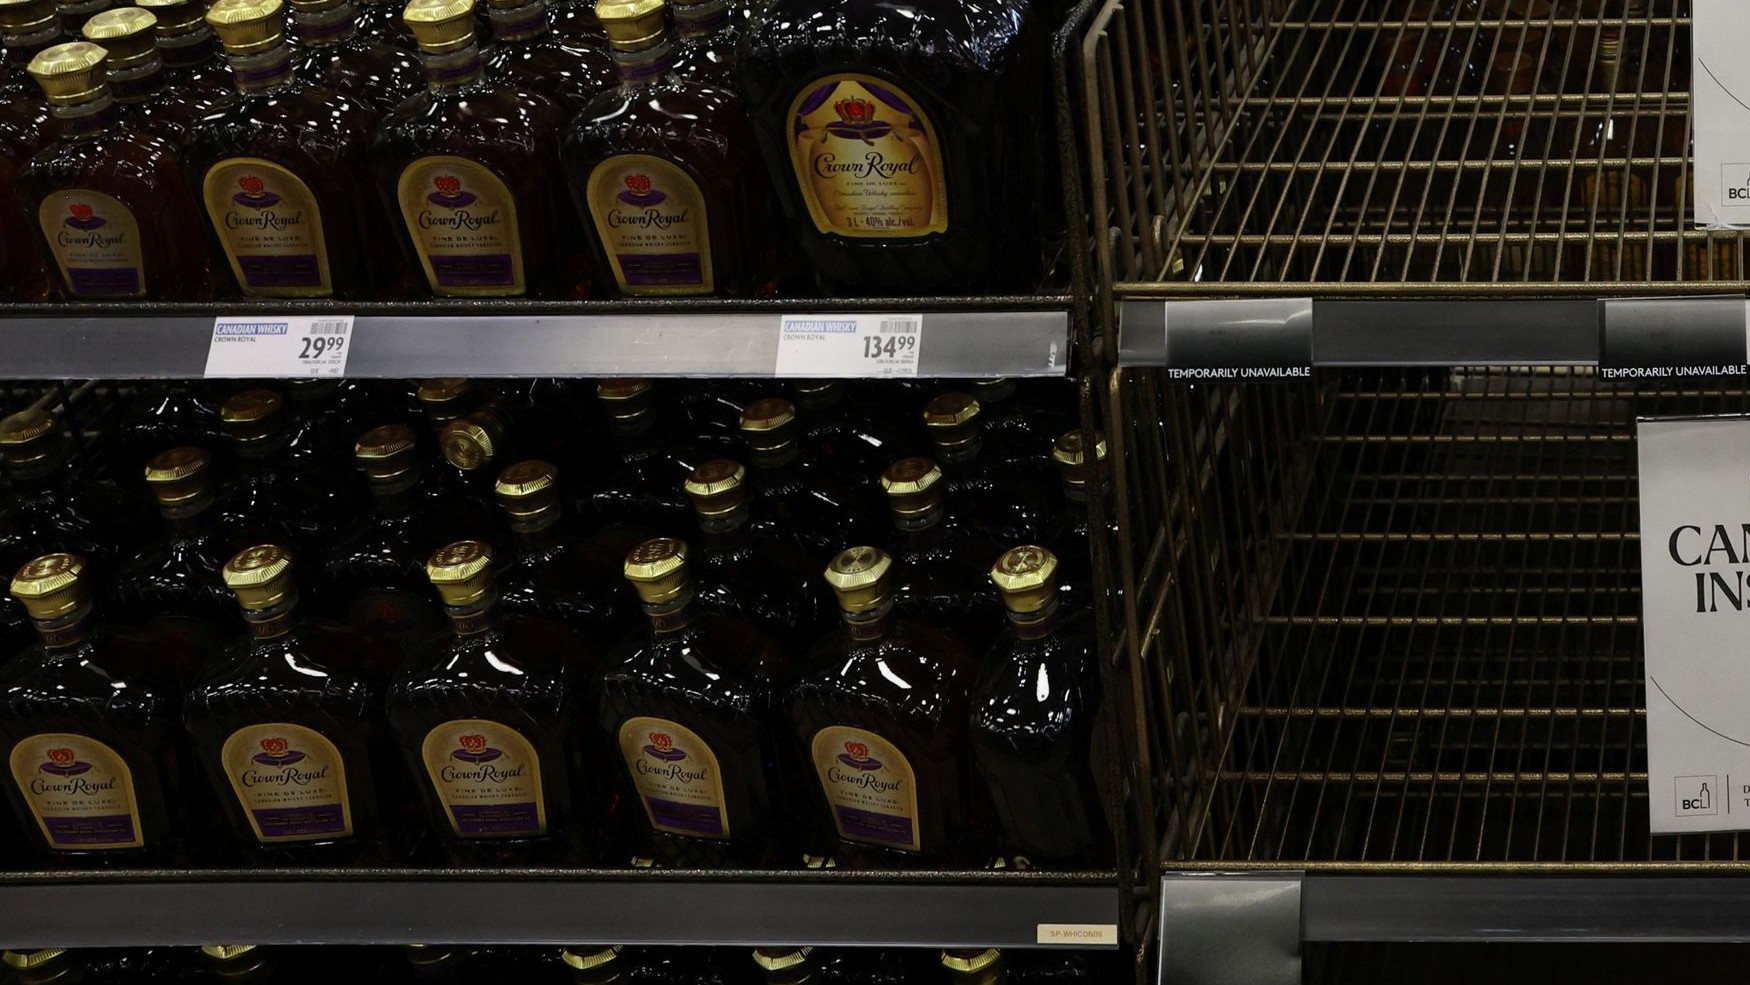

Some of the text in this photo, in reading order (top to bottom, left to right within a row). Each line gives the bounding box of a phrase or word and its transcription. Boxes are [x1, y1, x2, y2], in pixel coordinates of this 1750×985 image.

[814, 151, 921, 179] Crown Royal
[225, 210, 304, 231] Crown Royal
[419, 209, 500, 230] Crown Royal
[608, 209, 688, 230] Crown Royal
[58, 232, 126, 249] Crown Royal
[216, 323, 287, 335] CANADIAN WHISKY
[784, 321, 856, 332] CANADIAN WHISKY
[1168, 366, 1311, 379] TEMPORARILY UNAVAILABLE
[1602, 364, 1747, 378] TEMPORARILY UNAVAILABLE
[242, 766, 330, 788] Crown Royal
[441, 763, 524, 783] Crown Royal
[636, 761, 708, 783] Crown Royal
[828, 766, 903, 793] Crown Royal
[31, 778, 117, 796] Crown Royal
